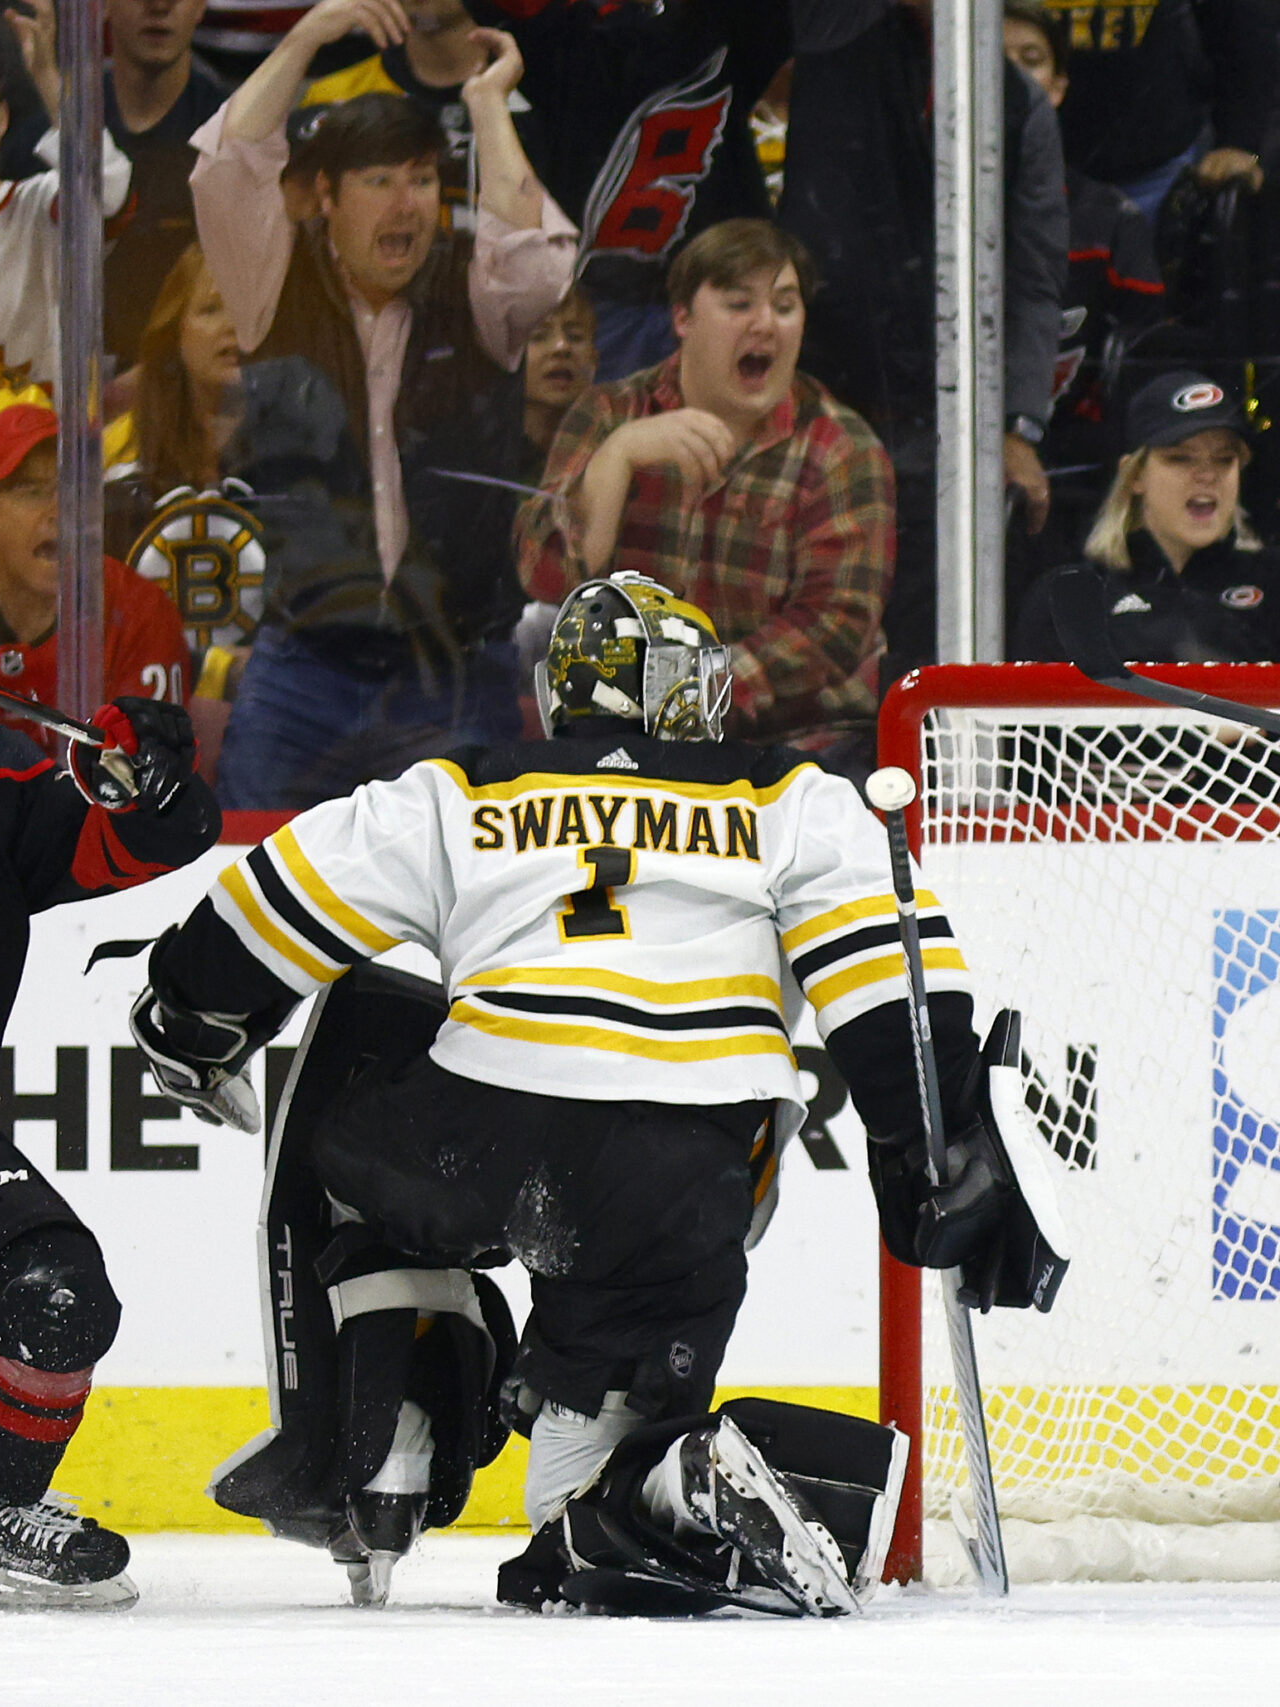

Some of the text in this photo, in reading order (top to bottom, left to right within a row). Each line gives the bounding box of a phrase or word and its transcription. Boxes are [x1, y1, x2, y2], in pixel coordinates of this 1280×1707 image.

[596, 757, 639, 770] adidas
[472, 794, 762, 864] SWAYMAN
[556, 844, 637, 945] 1
[276, 1223, 299, 1391] TRUE
